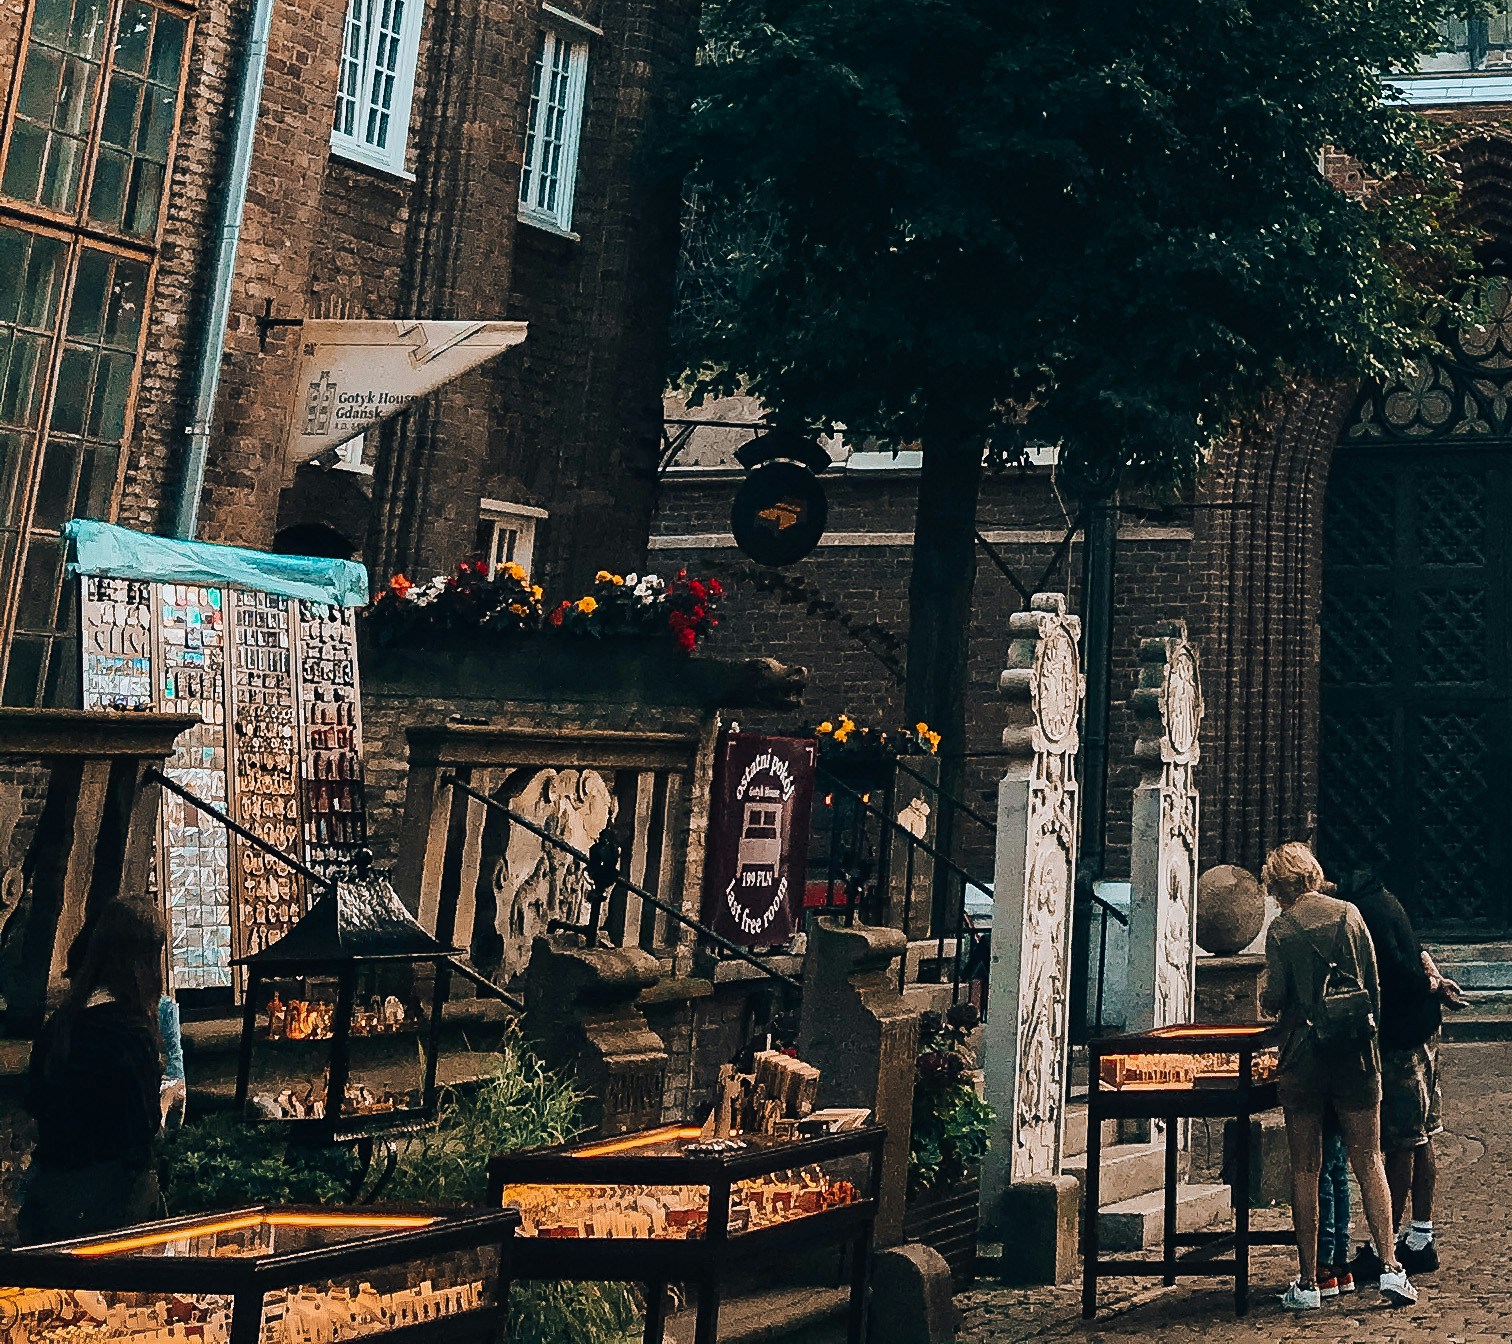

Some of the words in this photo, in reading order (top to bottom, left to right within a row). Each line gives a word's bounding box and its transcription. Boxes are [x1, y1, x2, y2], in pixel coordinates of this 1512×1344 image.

[338, 391, 375, 407] Gotyk
[335, 405, 383, 420] Gdańsk
[736, 748, 772, 800] ostatni
[769, 755, 795, 801] pokój
[741, 871, 756, 887] 199
[726, 878, 741, 923] last
[741, 908, 762, 934] free
[763, 876, 788, 928] room
